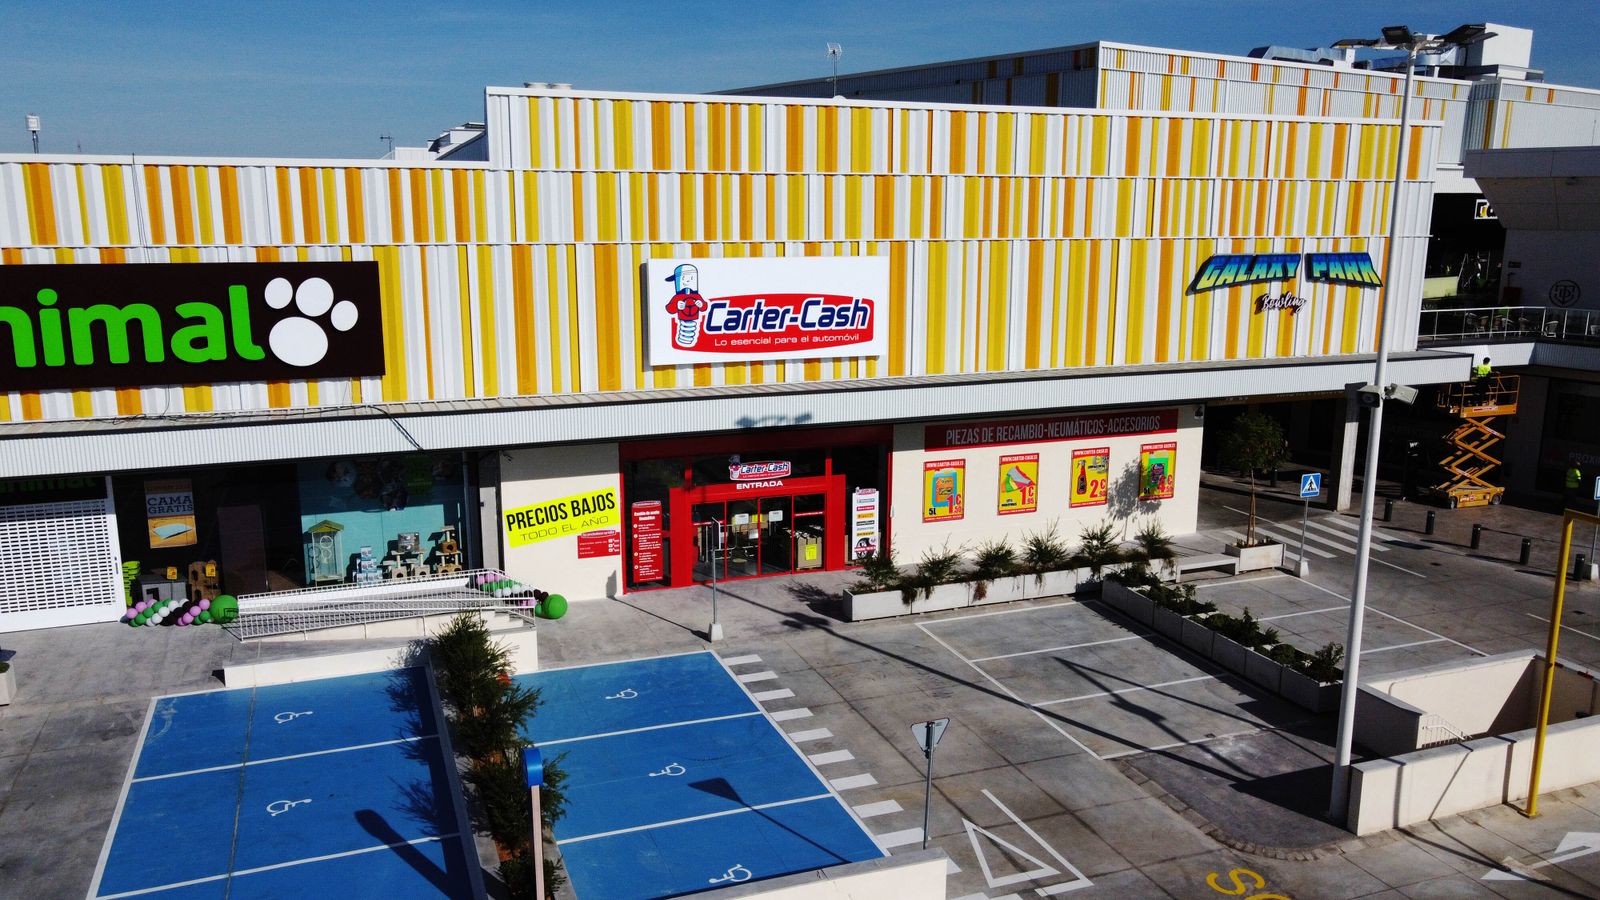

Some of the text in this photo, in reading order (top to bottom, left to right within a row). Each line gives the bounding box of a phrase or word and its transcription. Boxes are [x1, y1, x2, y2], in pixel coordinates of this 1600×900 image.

[1192, 253, 1382, 292] GALAXY PARK
[1261, 292, 1306, 313] Bowling
[705, 298, 869, 332] Carter-Cash
[714, 333, 860, 347] Lo esencial para el automóvil
[946, 428, 979, 446] PIEZAS
[981, 427, 994, 443] DE
[740, 463, 789, 474] Carter-Cash
[736, 480, 784, 490] ENTRADA
[147, 495, 192, 506] CAMA
[148, 504, 193, 514] GRATIS
[506, 492, 616, 532] PRECIOS BAJOS
[520, 515, 609, 541] TODO EL AÑO
